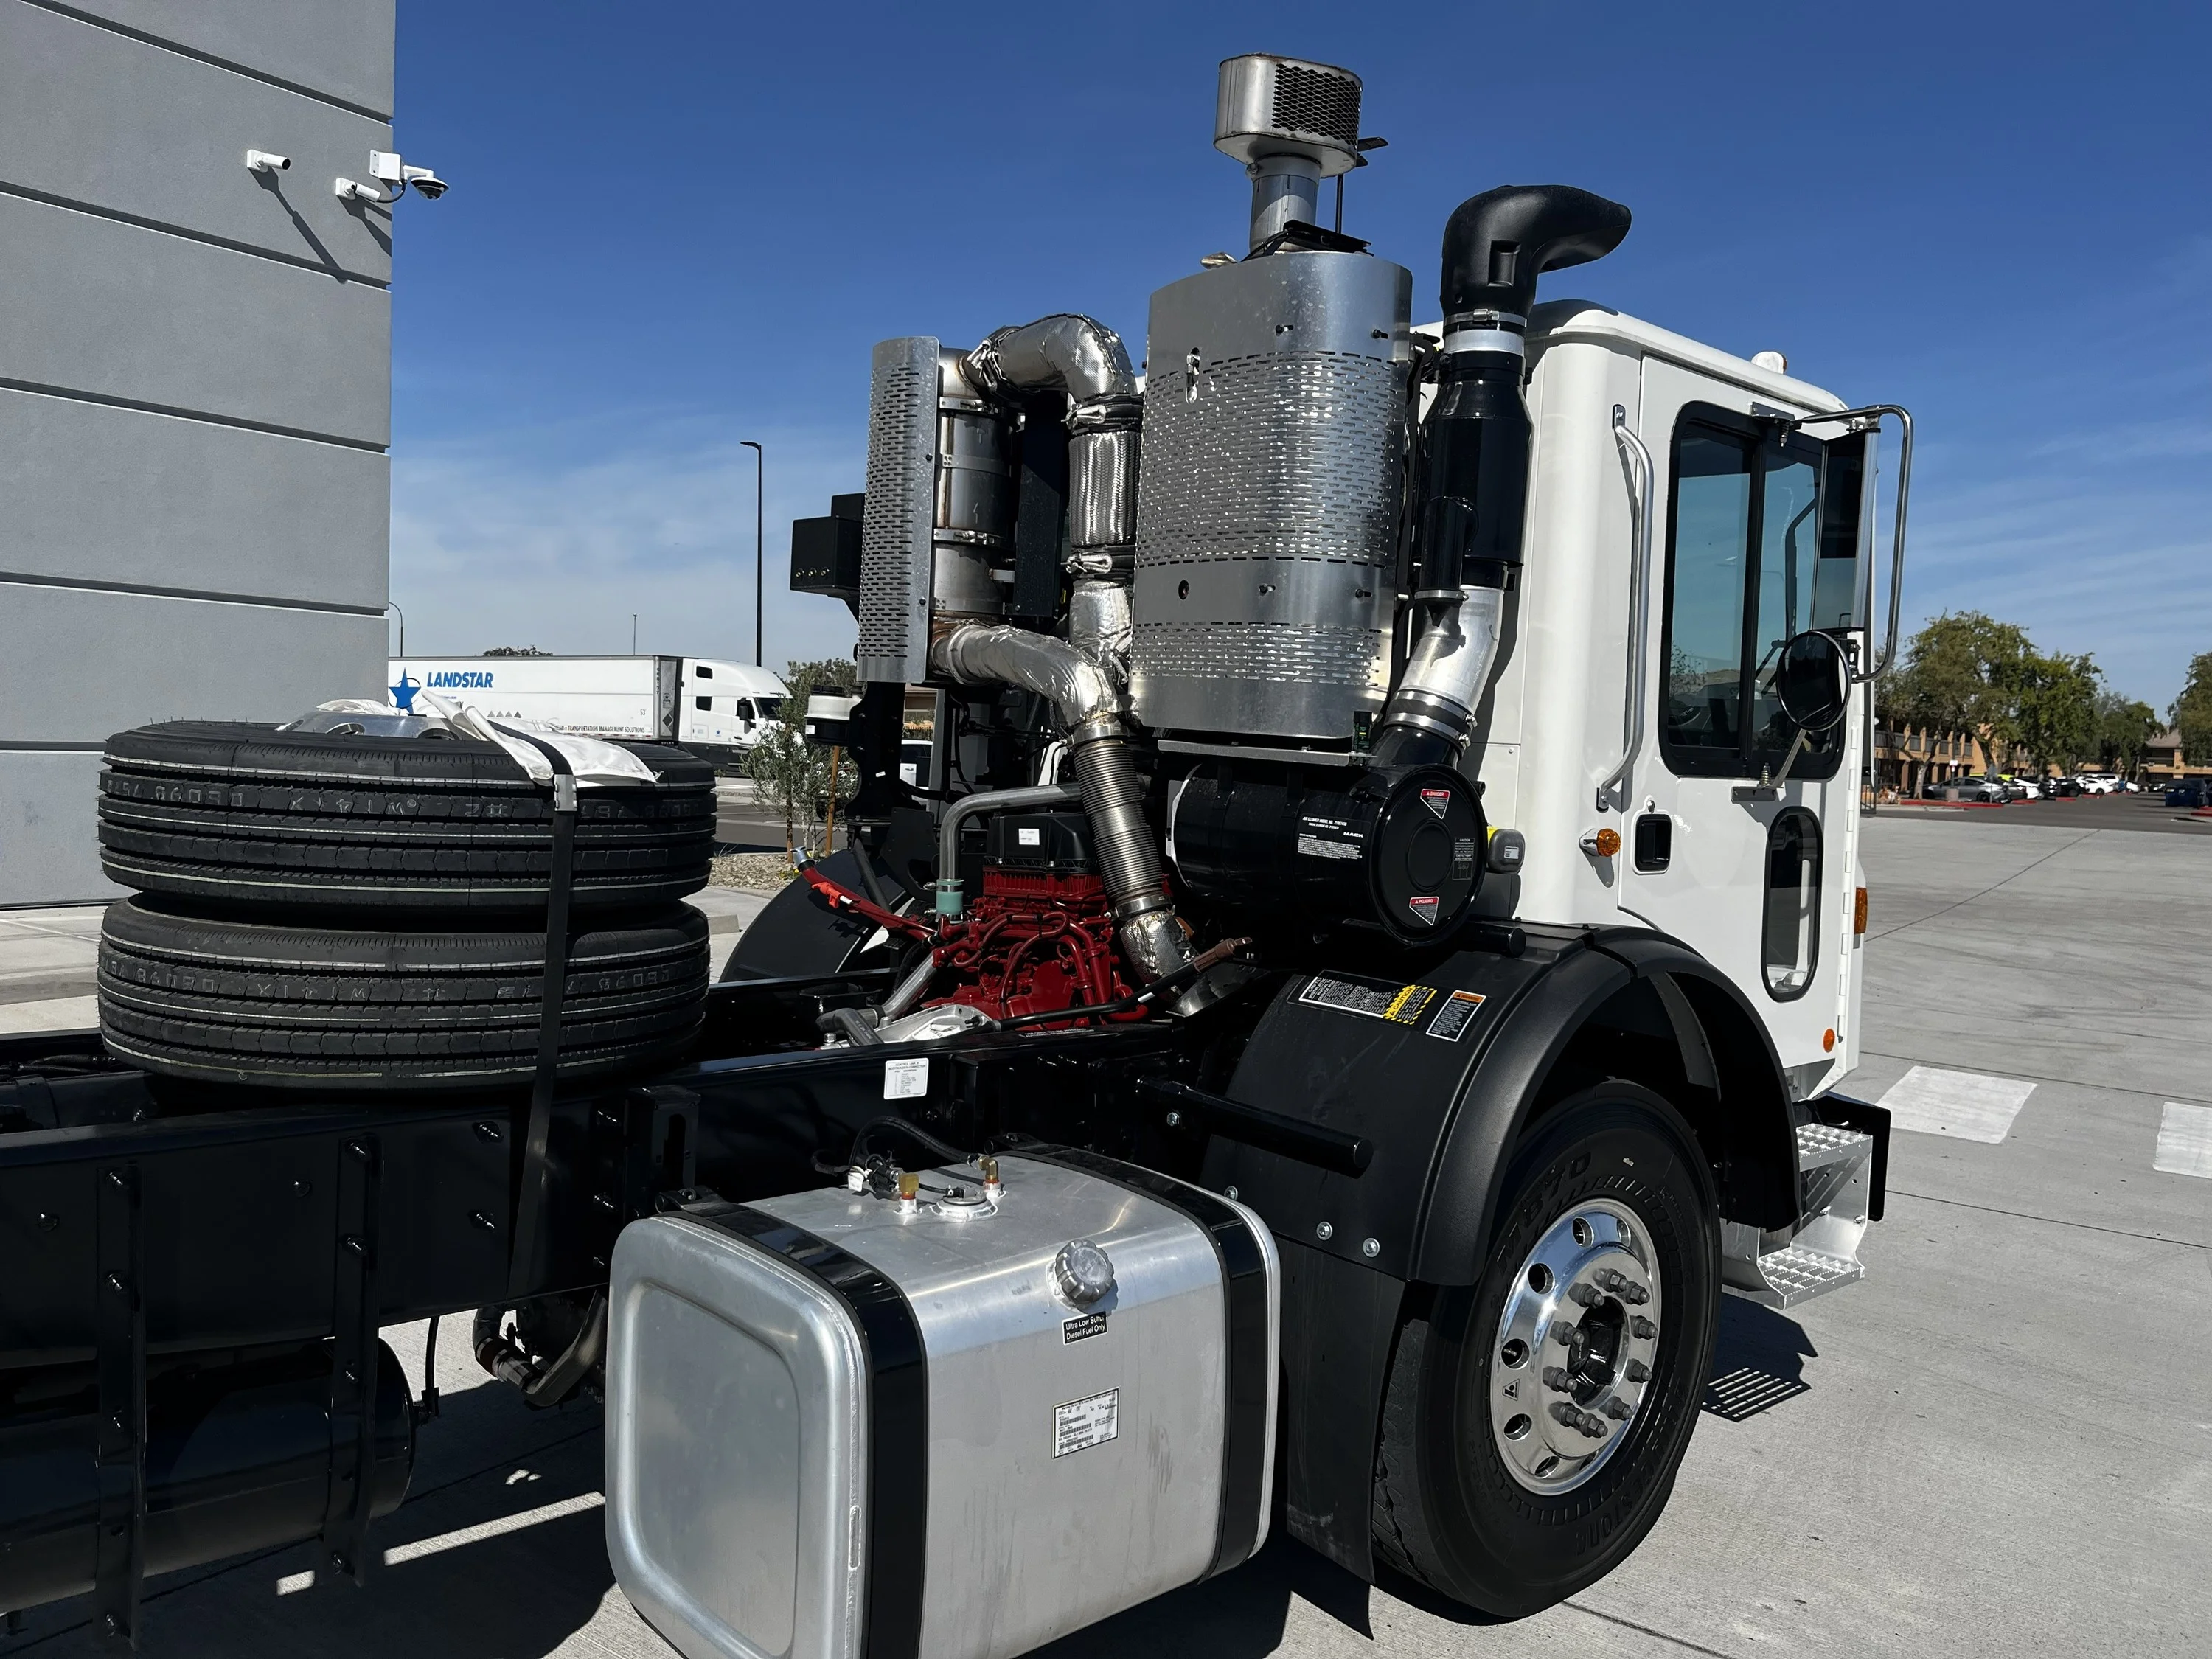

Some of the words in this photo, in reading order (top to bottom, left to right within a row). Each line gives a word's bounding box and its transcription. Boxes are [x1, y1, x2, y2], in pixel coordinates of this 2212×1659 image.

[427, 672, 493, 688] LANDSTAR
[1393, 987, 1413, 1010] CAUTION
[1066, 1322, 1078, 1330] Ultra
[1079, 1319, 1090, 1327] Low
[1066, 1329, 1082, 1340] Diesel
[1094, 1324, 1105, 1332] Only
